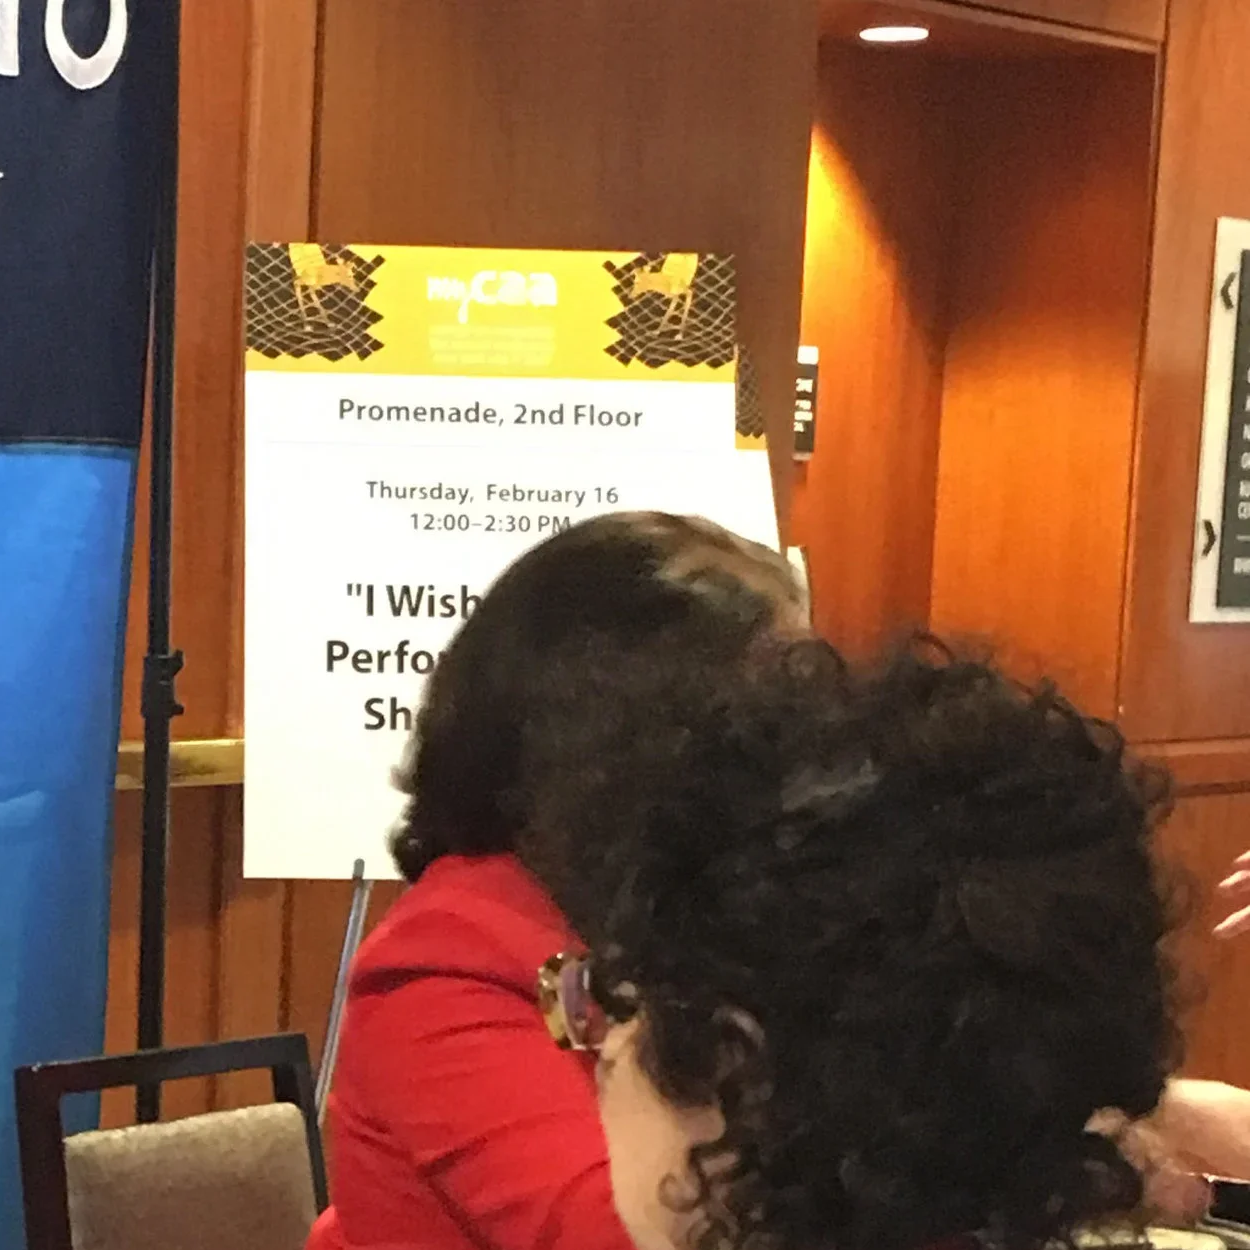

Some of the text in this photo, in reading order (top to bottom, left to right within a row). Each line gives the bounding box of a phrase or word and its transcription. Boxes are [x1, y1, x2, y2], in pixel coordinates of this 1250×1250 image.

[338, 398, 644, 427] Promenade, 2nd Floor
[365, 481, 619, 508] Thursday, February 16
[386, 584, 482, 620] Wish
[326, 639, 447, 675] Perfo
